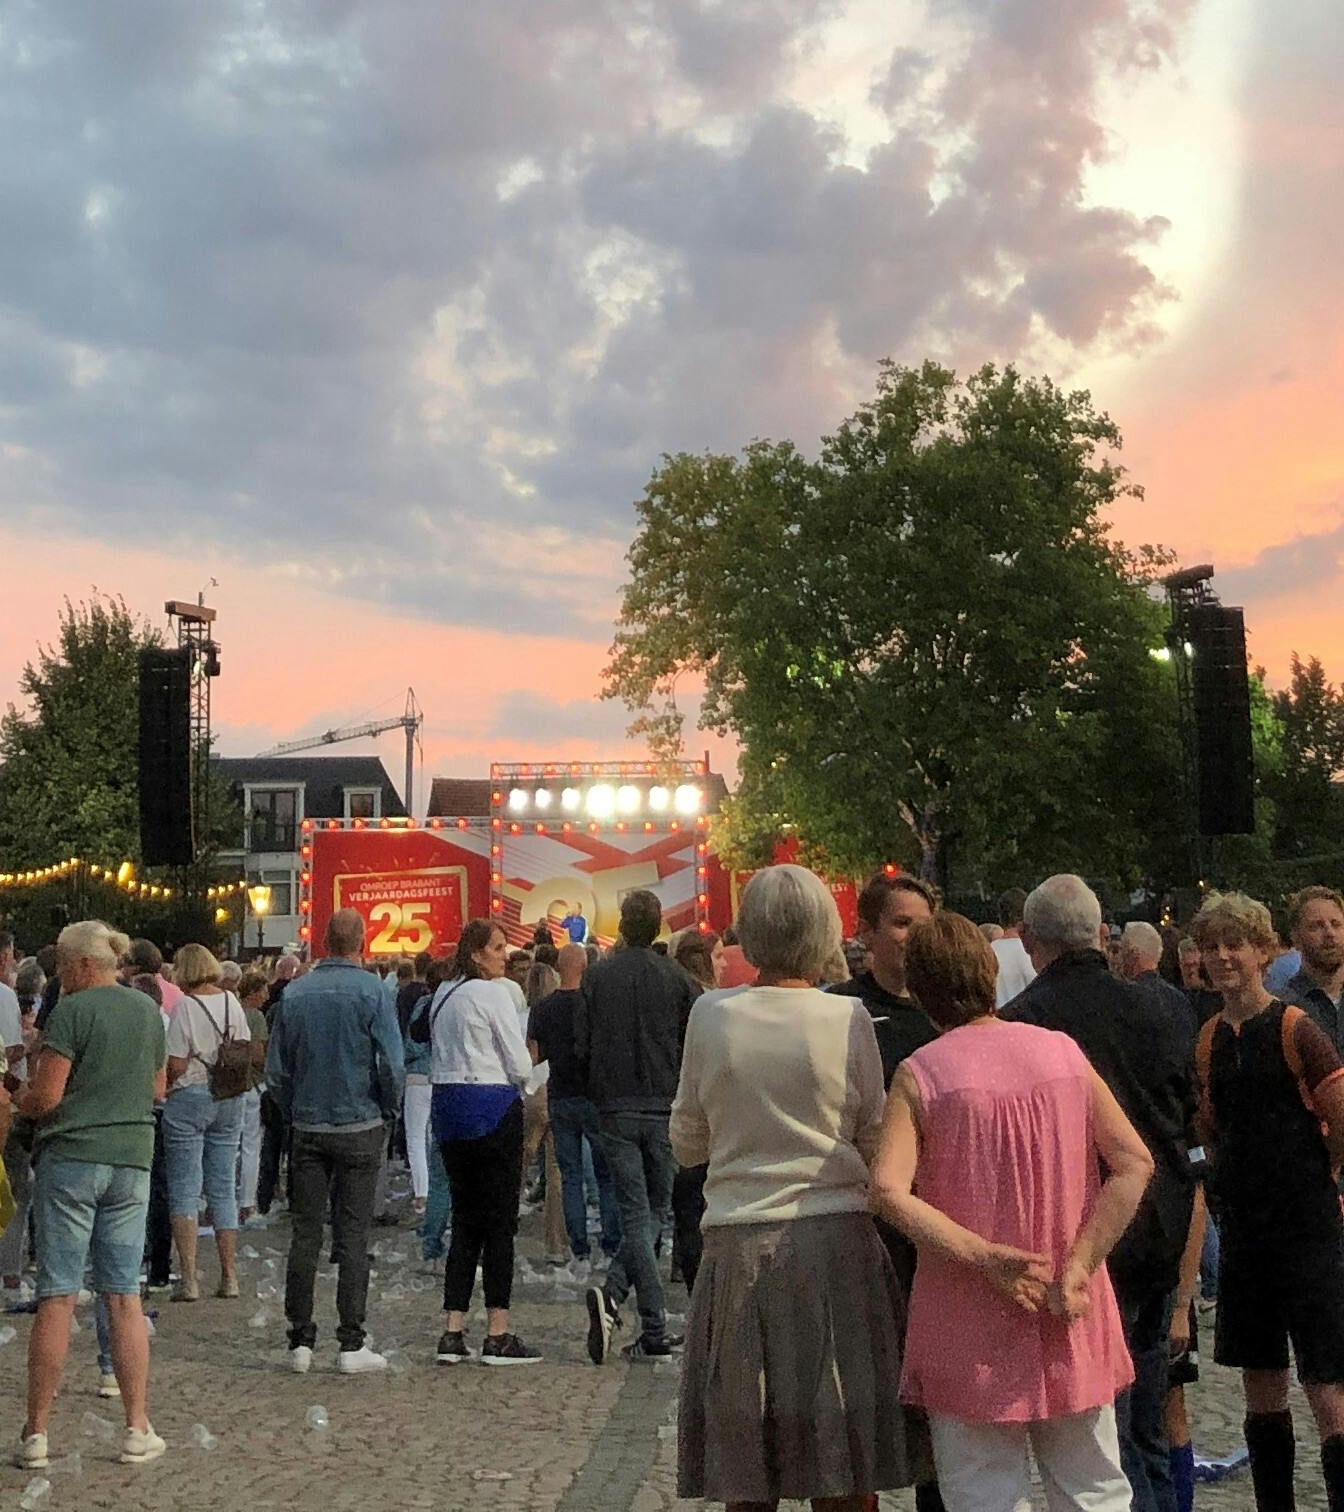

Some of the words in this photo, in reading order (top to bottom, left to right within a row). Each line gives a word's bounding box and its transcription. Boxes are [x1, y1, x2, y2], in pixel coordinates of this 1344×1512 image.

[360, 880, 399, 892] OMROEP
[400, 878, 441, 889] BRABANT
[348, 886, 454, 902] VERJAARDAGSFEEST
[369, 902, 433, 953] 25
